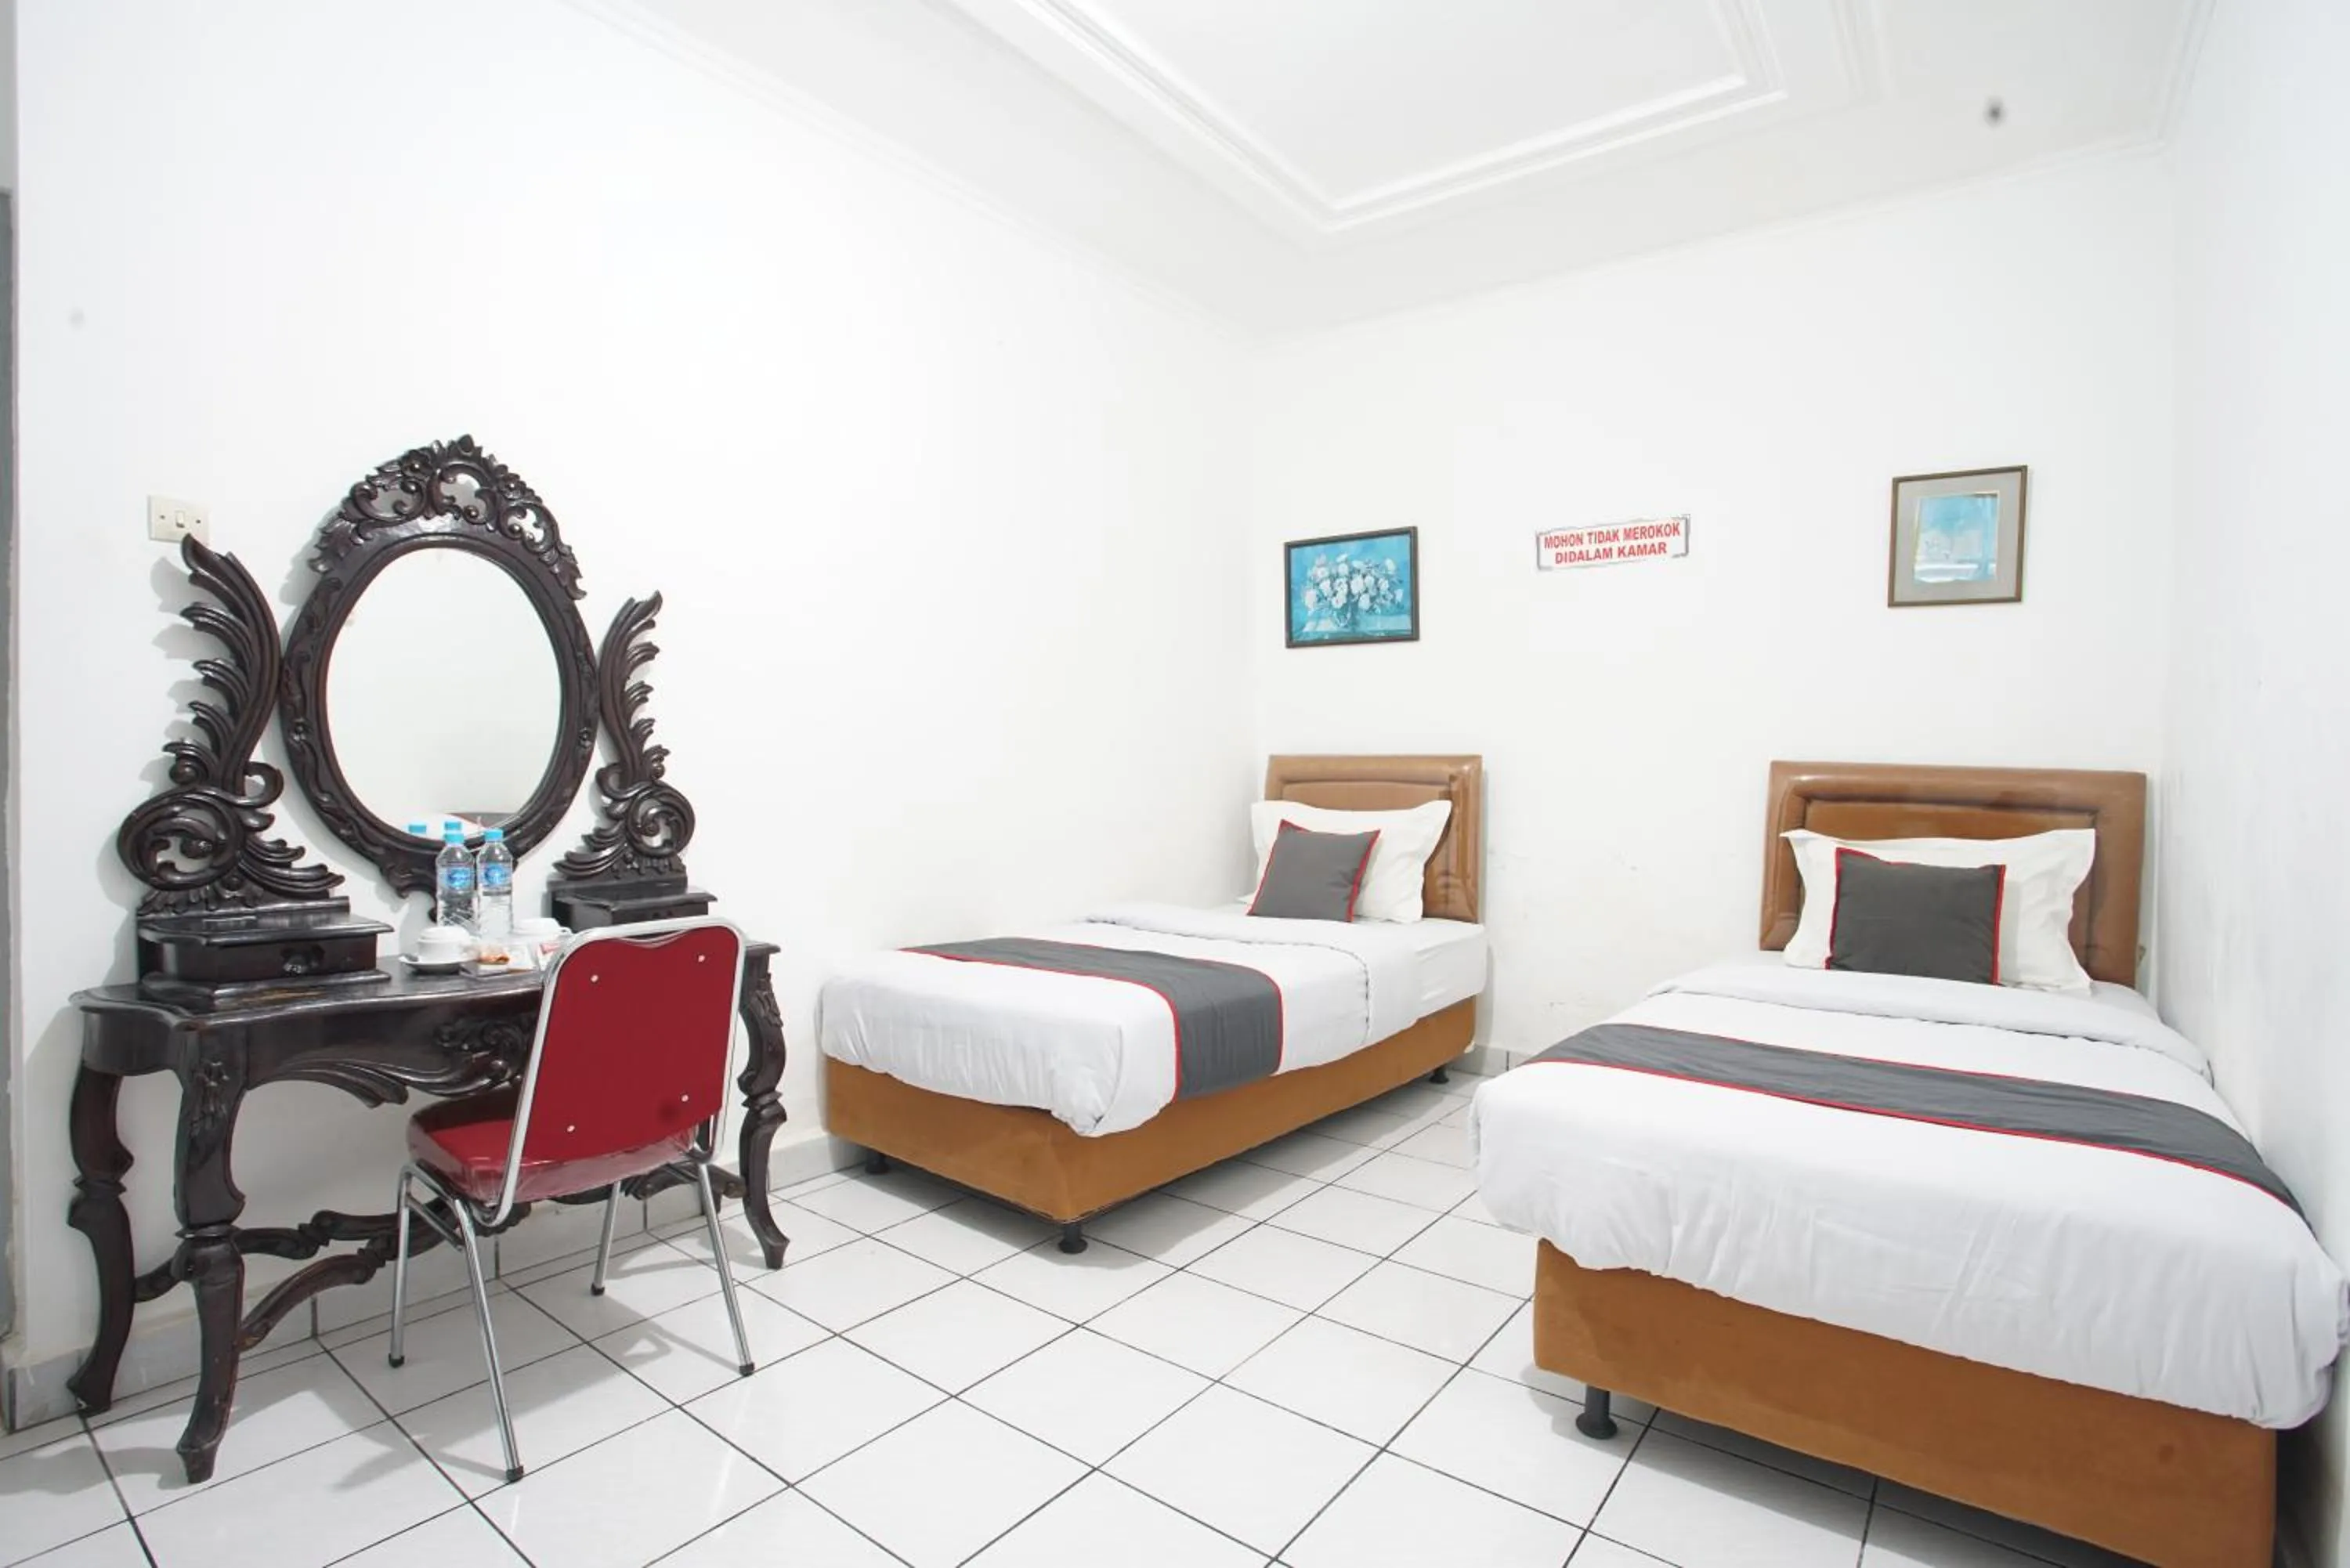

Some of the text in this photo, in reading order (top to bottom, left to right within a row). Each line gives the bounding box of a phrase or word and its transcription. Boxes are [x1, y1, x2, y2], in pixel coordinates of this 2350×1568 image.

[1544, 522, 1680, 549] MOHON TIDAK MEROKOK
[1555, 542, 1667, 564] DIDALAM KAMAR
